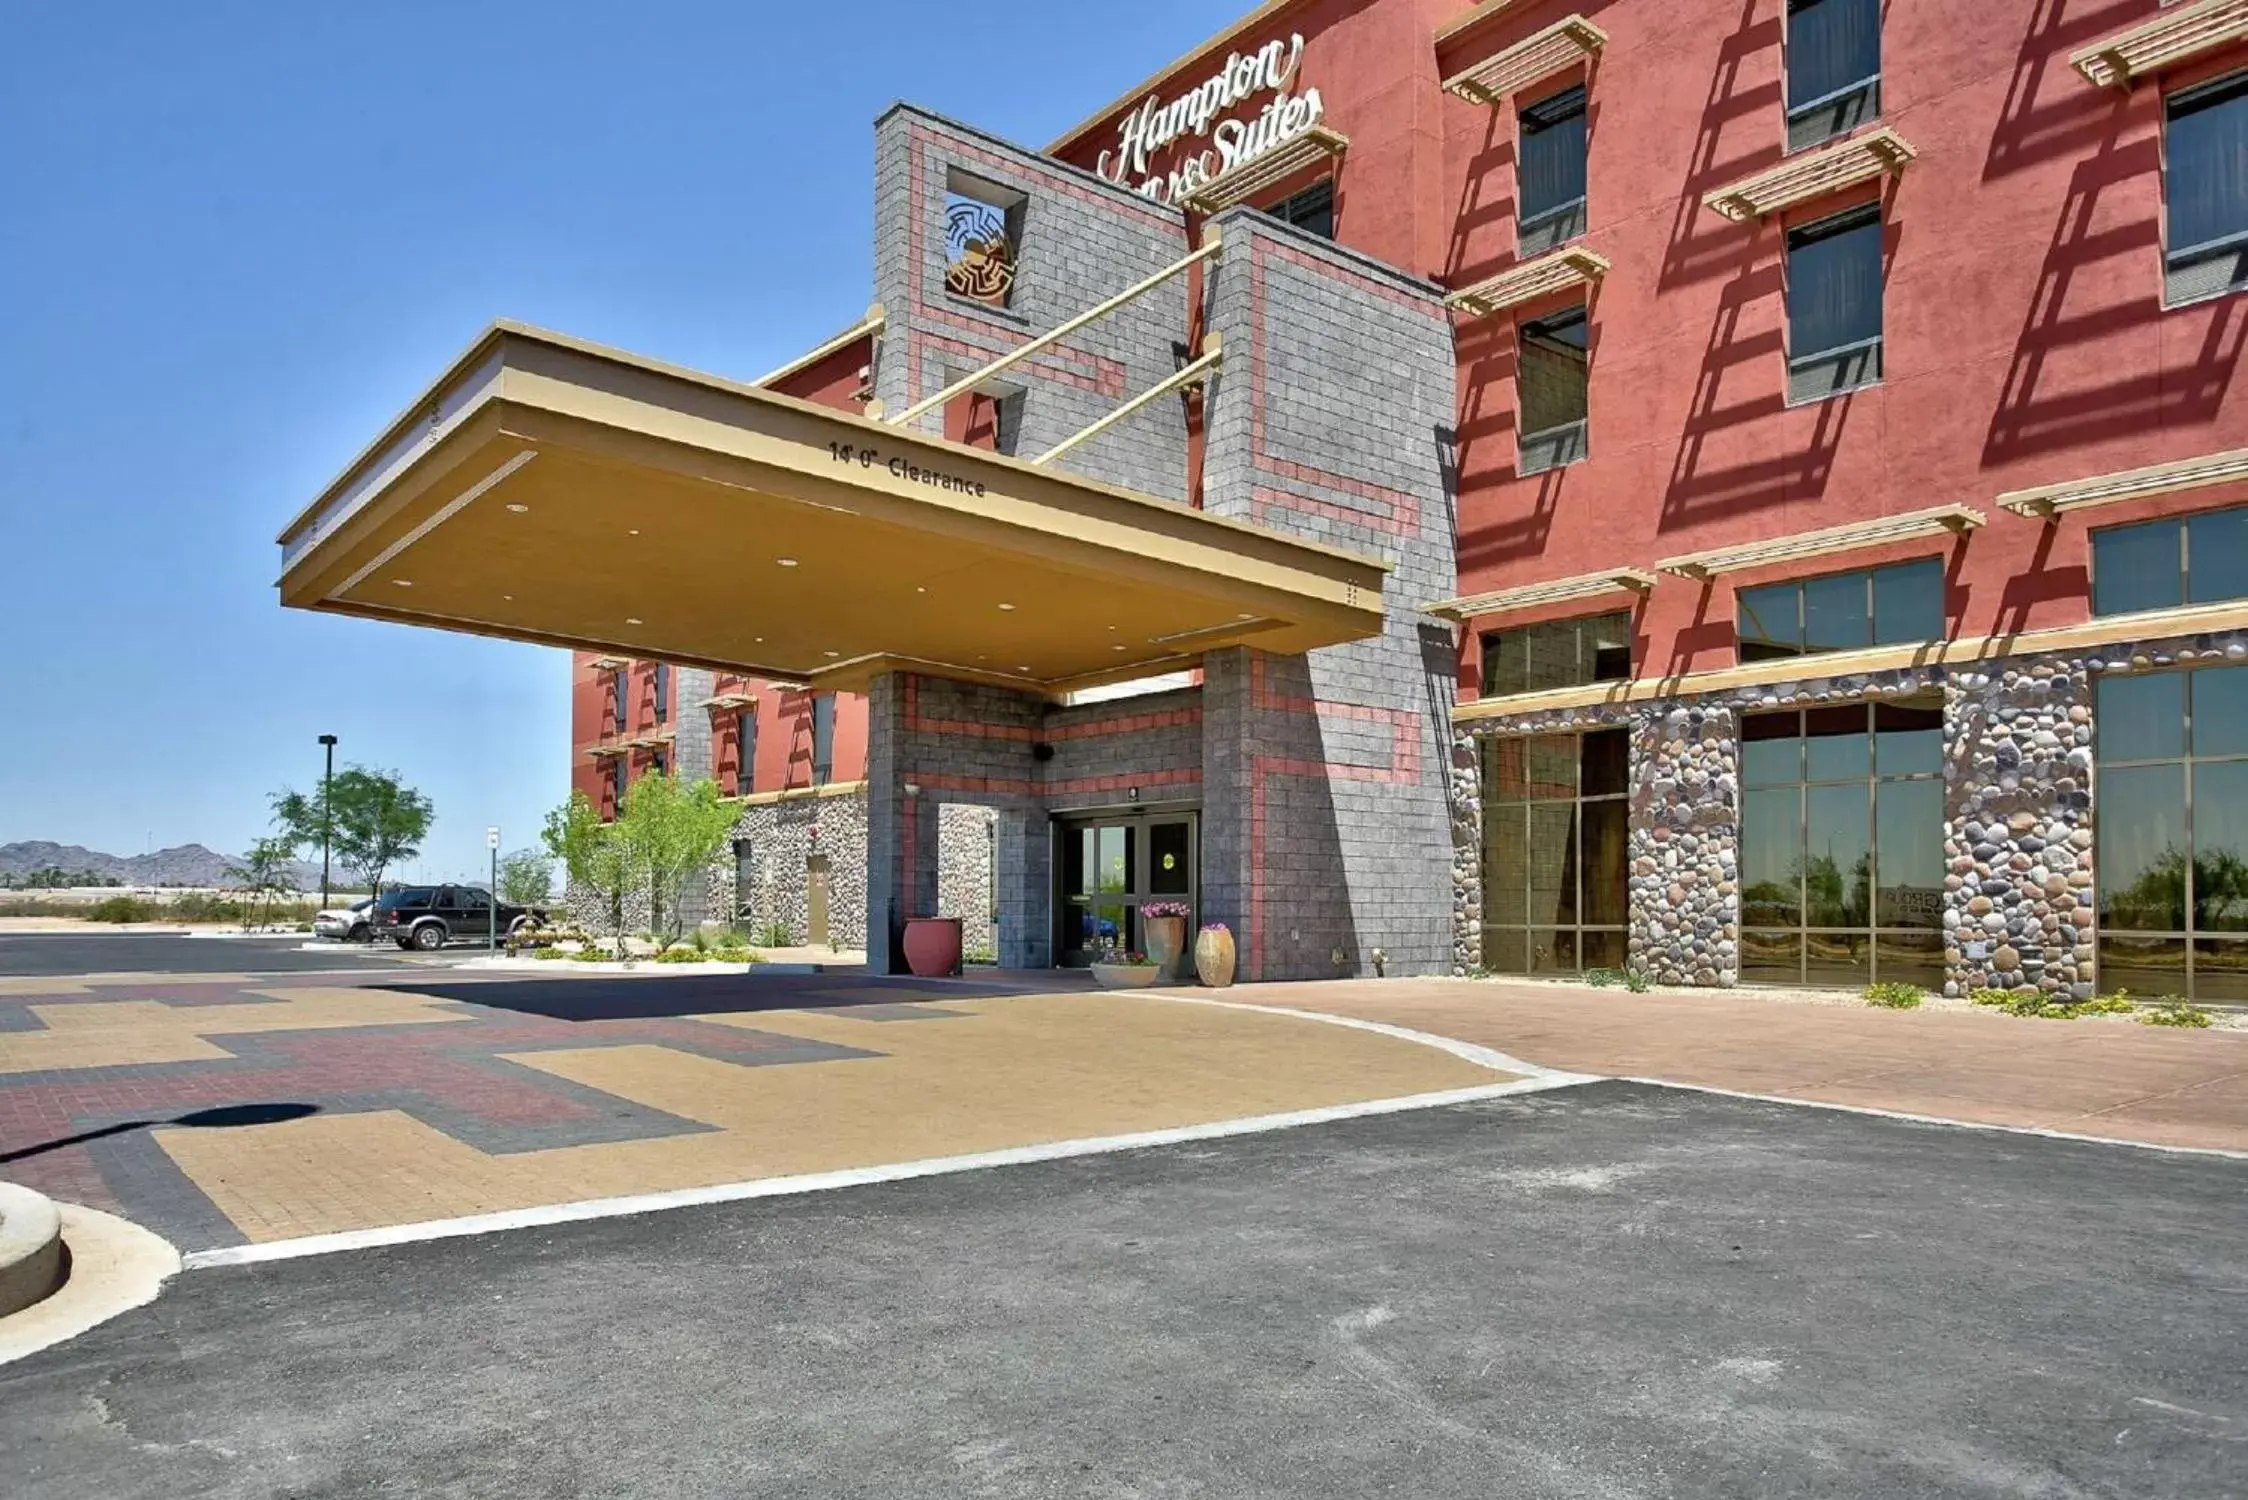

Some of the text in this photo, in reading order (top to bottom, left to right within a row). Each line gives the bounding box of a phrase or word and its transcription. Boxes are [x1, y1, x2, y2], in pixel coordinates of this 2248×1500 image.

[1097, 33, 1304, 183] Hampton
[1200, 87, 1324, 183] Suites
[888, 456, 986, 498] Clearance
